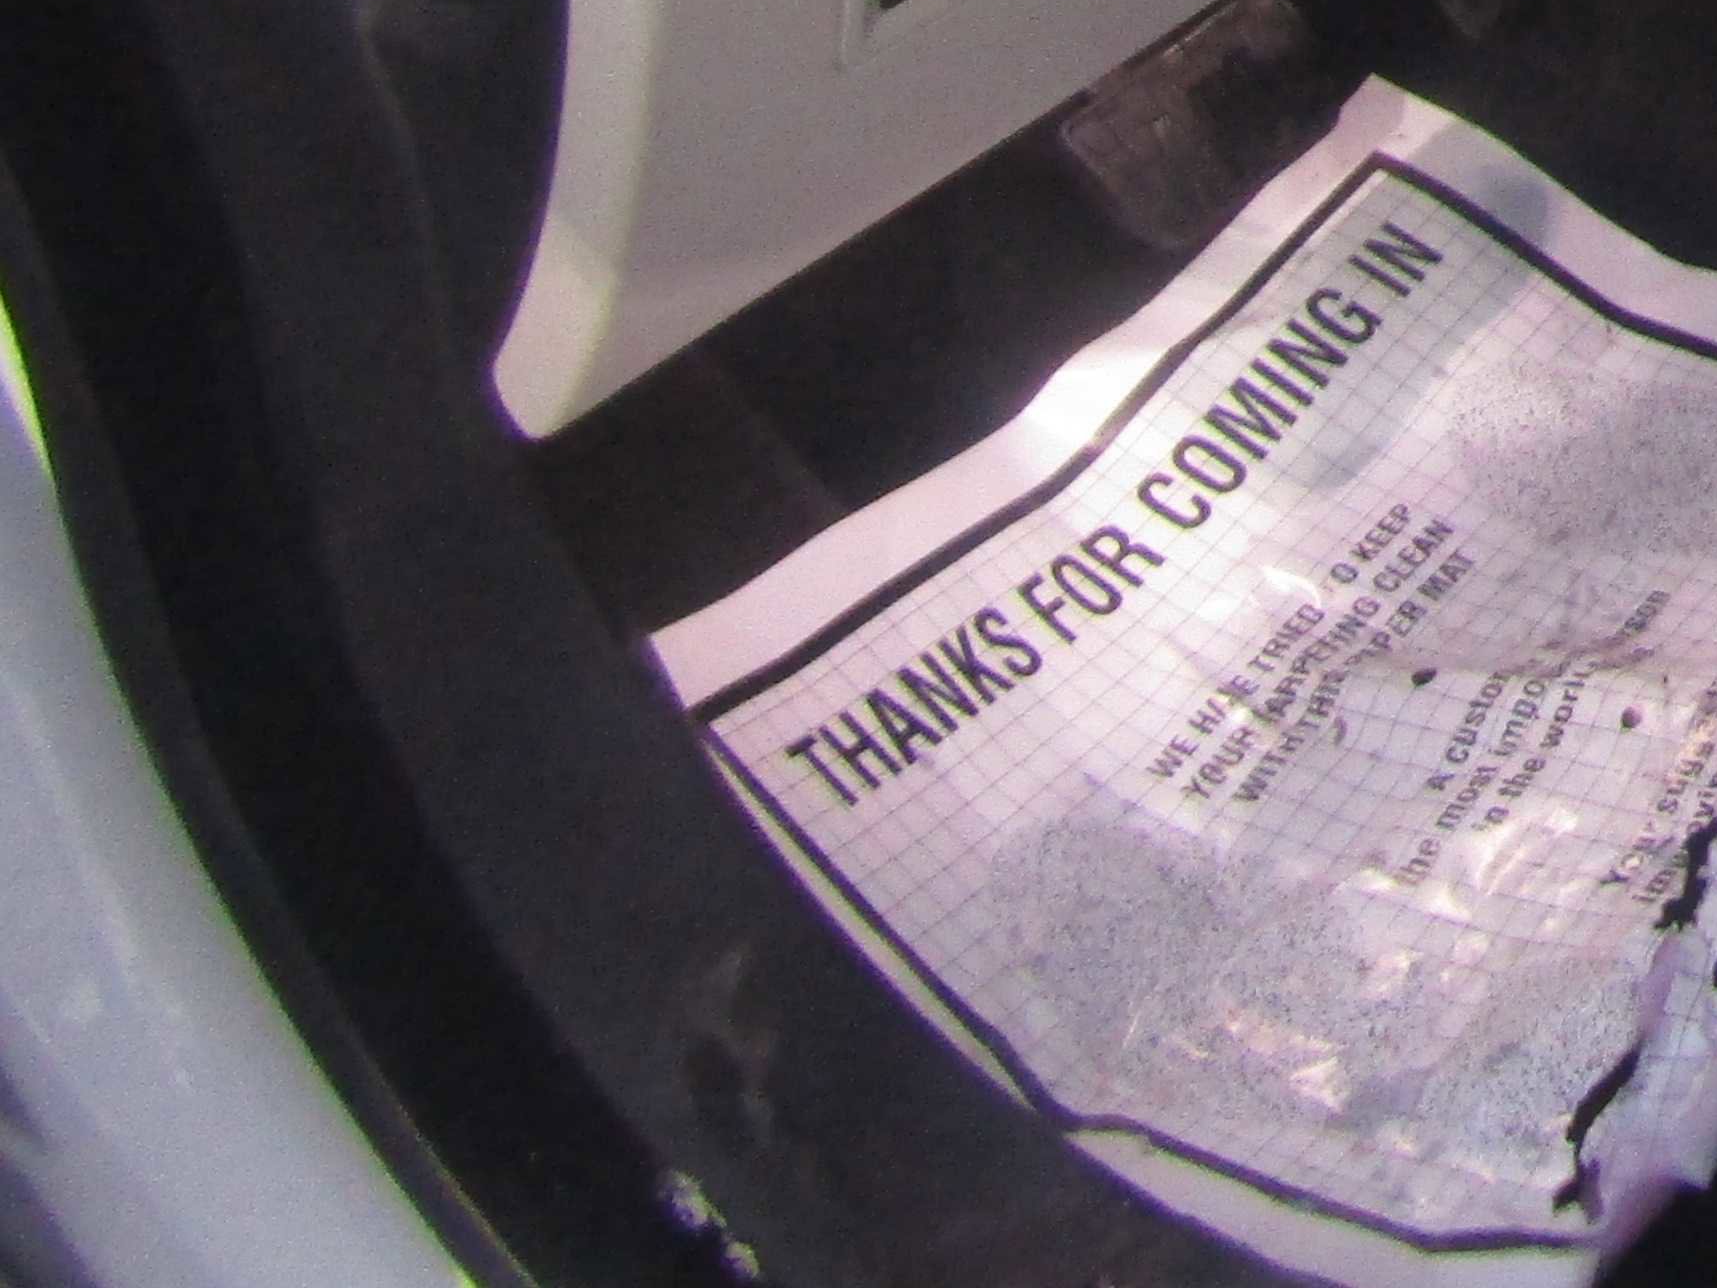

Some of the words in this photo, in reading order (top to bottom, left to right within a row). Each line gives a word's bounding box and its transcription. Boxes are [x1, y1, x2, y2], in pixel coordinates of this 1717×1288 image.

[787, 604, 1044, 805] THANKS
[1016, 522, 1164, 644] FOR
[1135, 286, 1383, 532] COMING
[1348, 222, 1444, 301] IN
[1147, 734, 1199, 778] WE
[1249, 603, 1325, 673] TRIED
[1351, 503, 1411, 562] KEEP
[1416, 548, 1476, 602] MAT
[1182, 726, 1255, 799] YOUR
[1373, 518, 1455, 593] CLEAN
[1498, 757, 1546, 798] the
